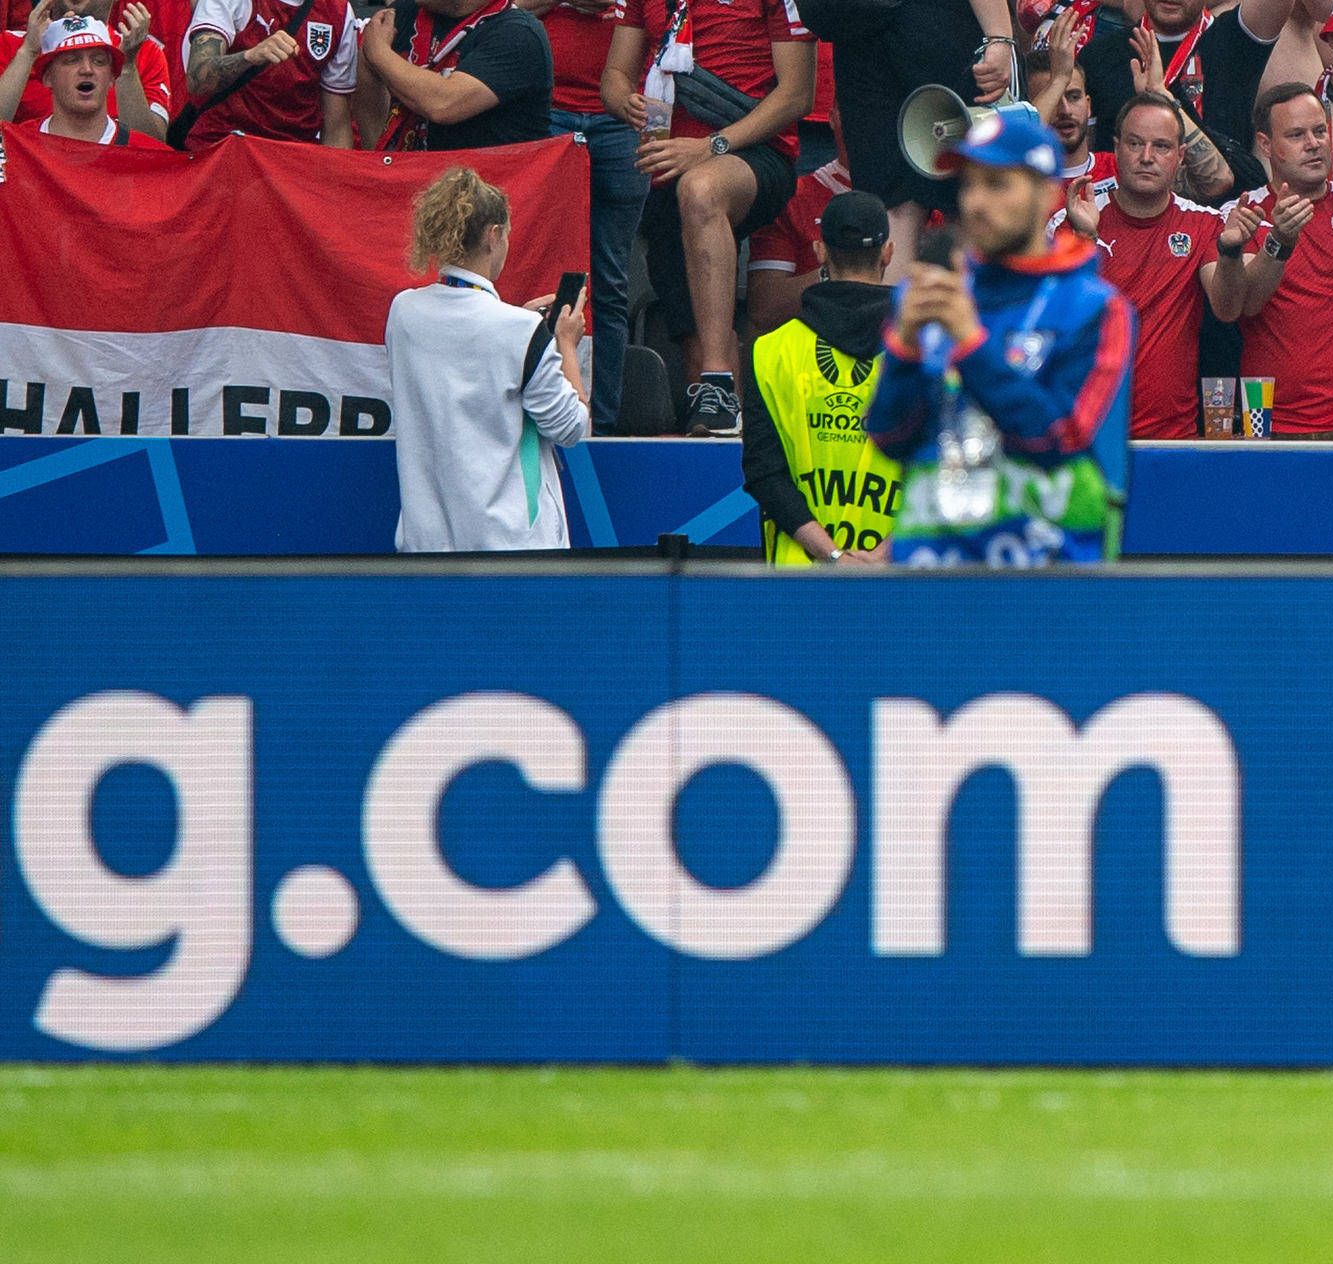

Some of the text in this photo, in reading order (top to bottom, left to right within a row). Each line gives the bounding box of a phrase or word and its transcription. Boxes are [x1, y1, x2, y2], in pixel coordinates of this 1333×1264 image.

[825, 394, 860, 410] UEFA
[816, 431, 869, 445] GERMANY
[13, 690, 1240, 1051] g.com
